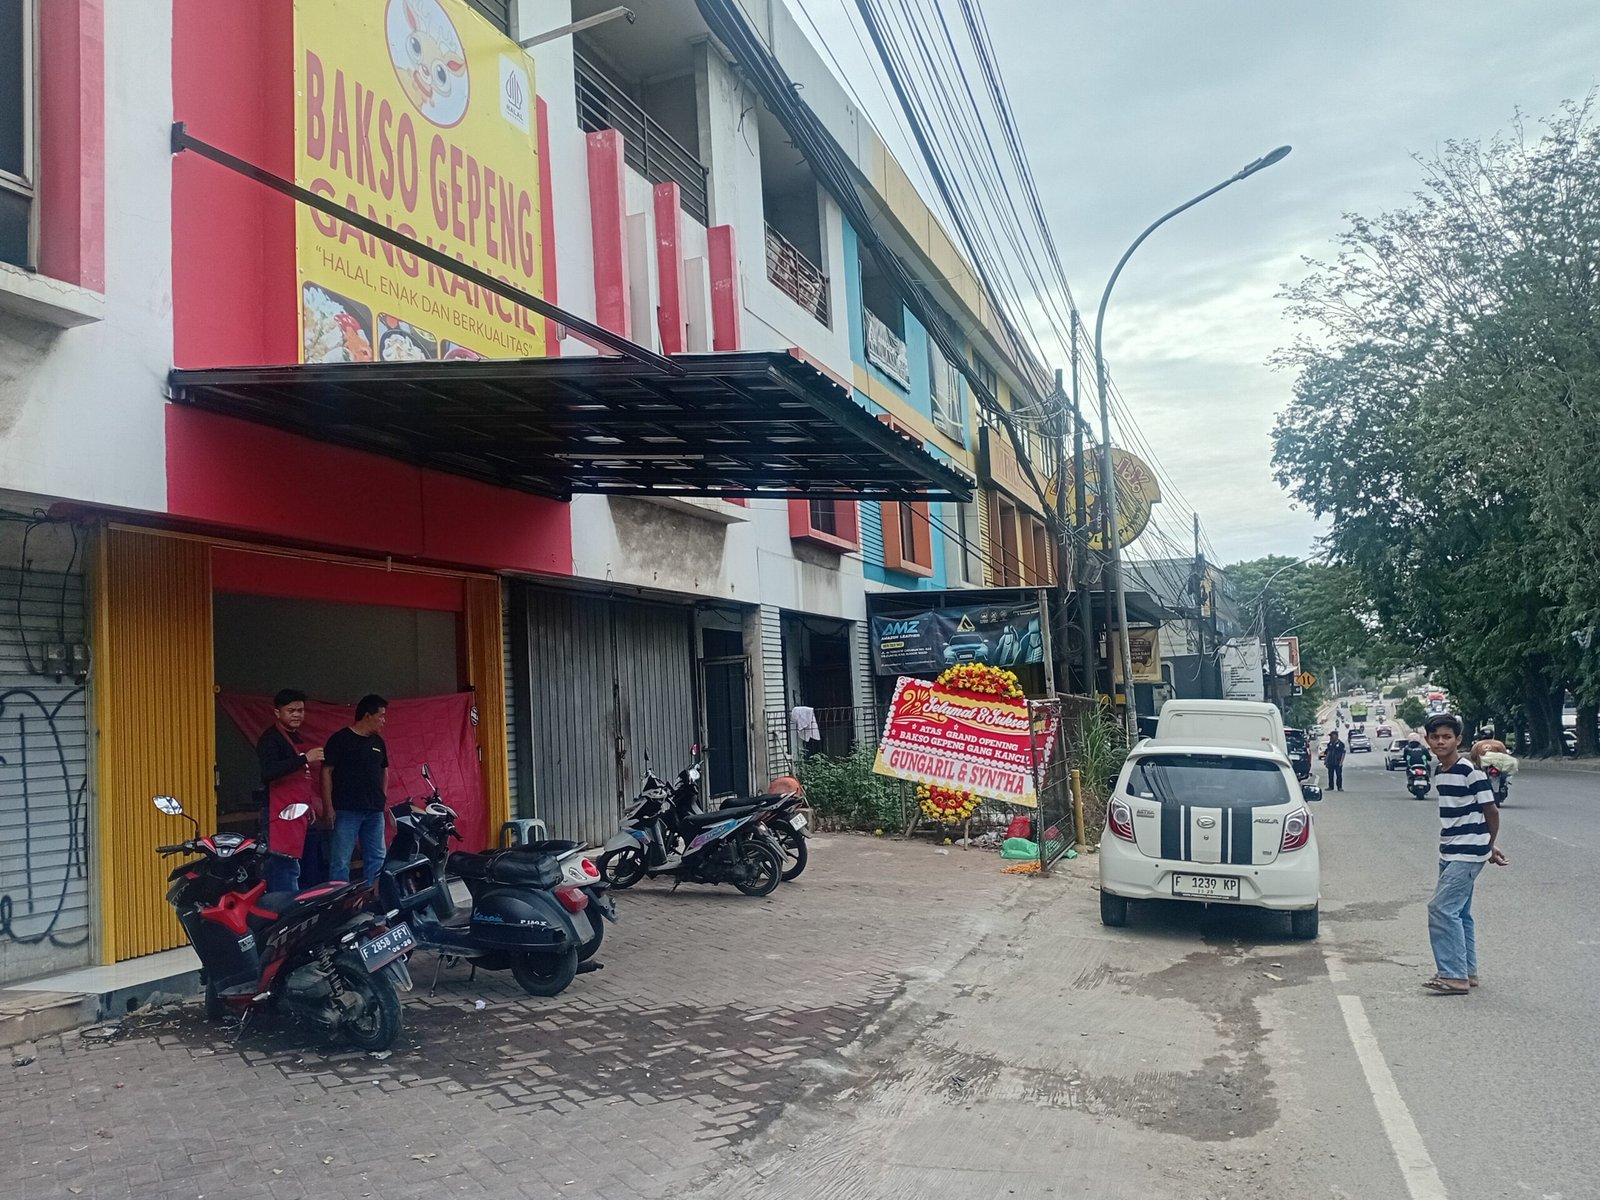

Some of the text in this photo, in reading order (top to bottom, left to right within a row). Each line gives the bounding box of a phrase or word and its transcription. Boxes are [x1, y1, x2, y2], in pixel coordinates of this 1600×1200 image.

[306, 49, 534, 278] BAKSO GEPENG
[309, 177, 419, 278] GANG
[380, 276, 419, 309] ENAK
[422, 297, 450, 323] DAN
[881, 620, 920, 636] AMZ
[922, 696, 1030, 730] Selamat & Sukses
[900, 731, 930, 744] BAKSO
[931, 737, 966, 751] GEPENG
[967, 744, 993, 757] GANG
[919, 725, 1019, 751] ATAS GRAND OPENING
[890, 748, 1025, 795] GUNGARIL & SYNTHA
[1175, 876, 1237, 891] F 1239 KP
[362, 927, 408, 959] F 2858 FFY
